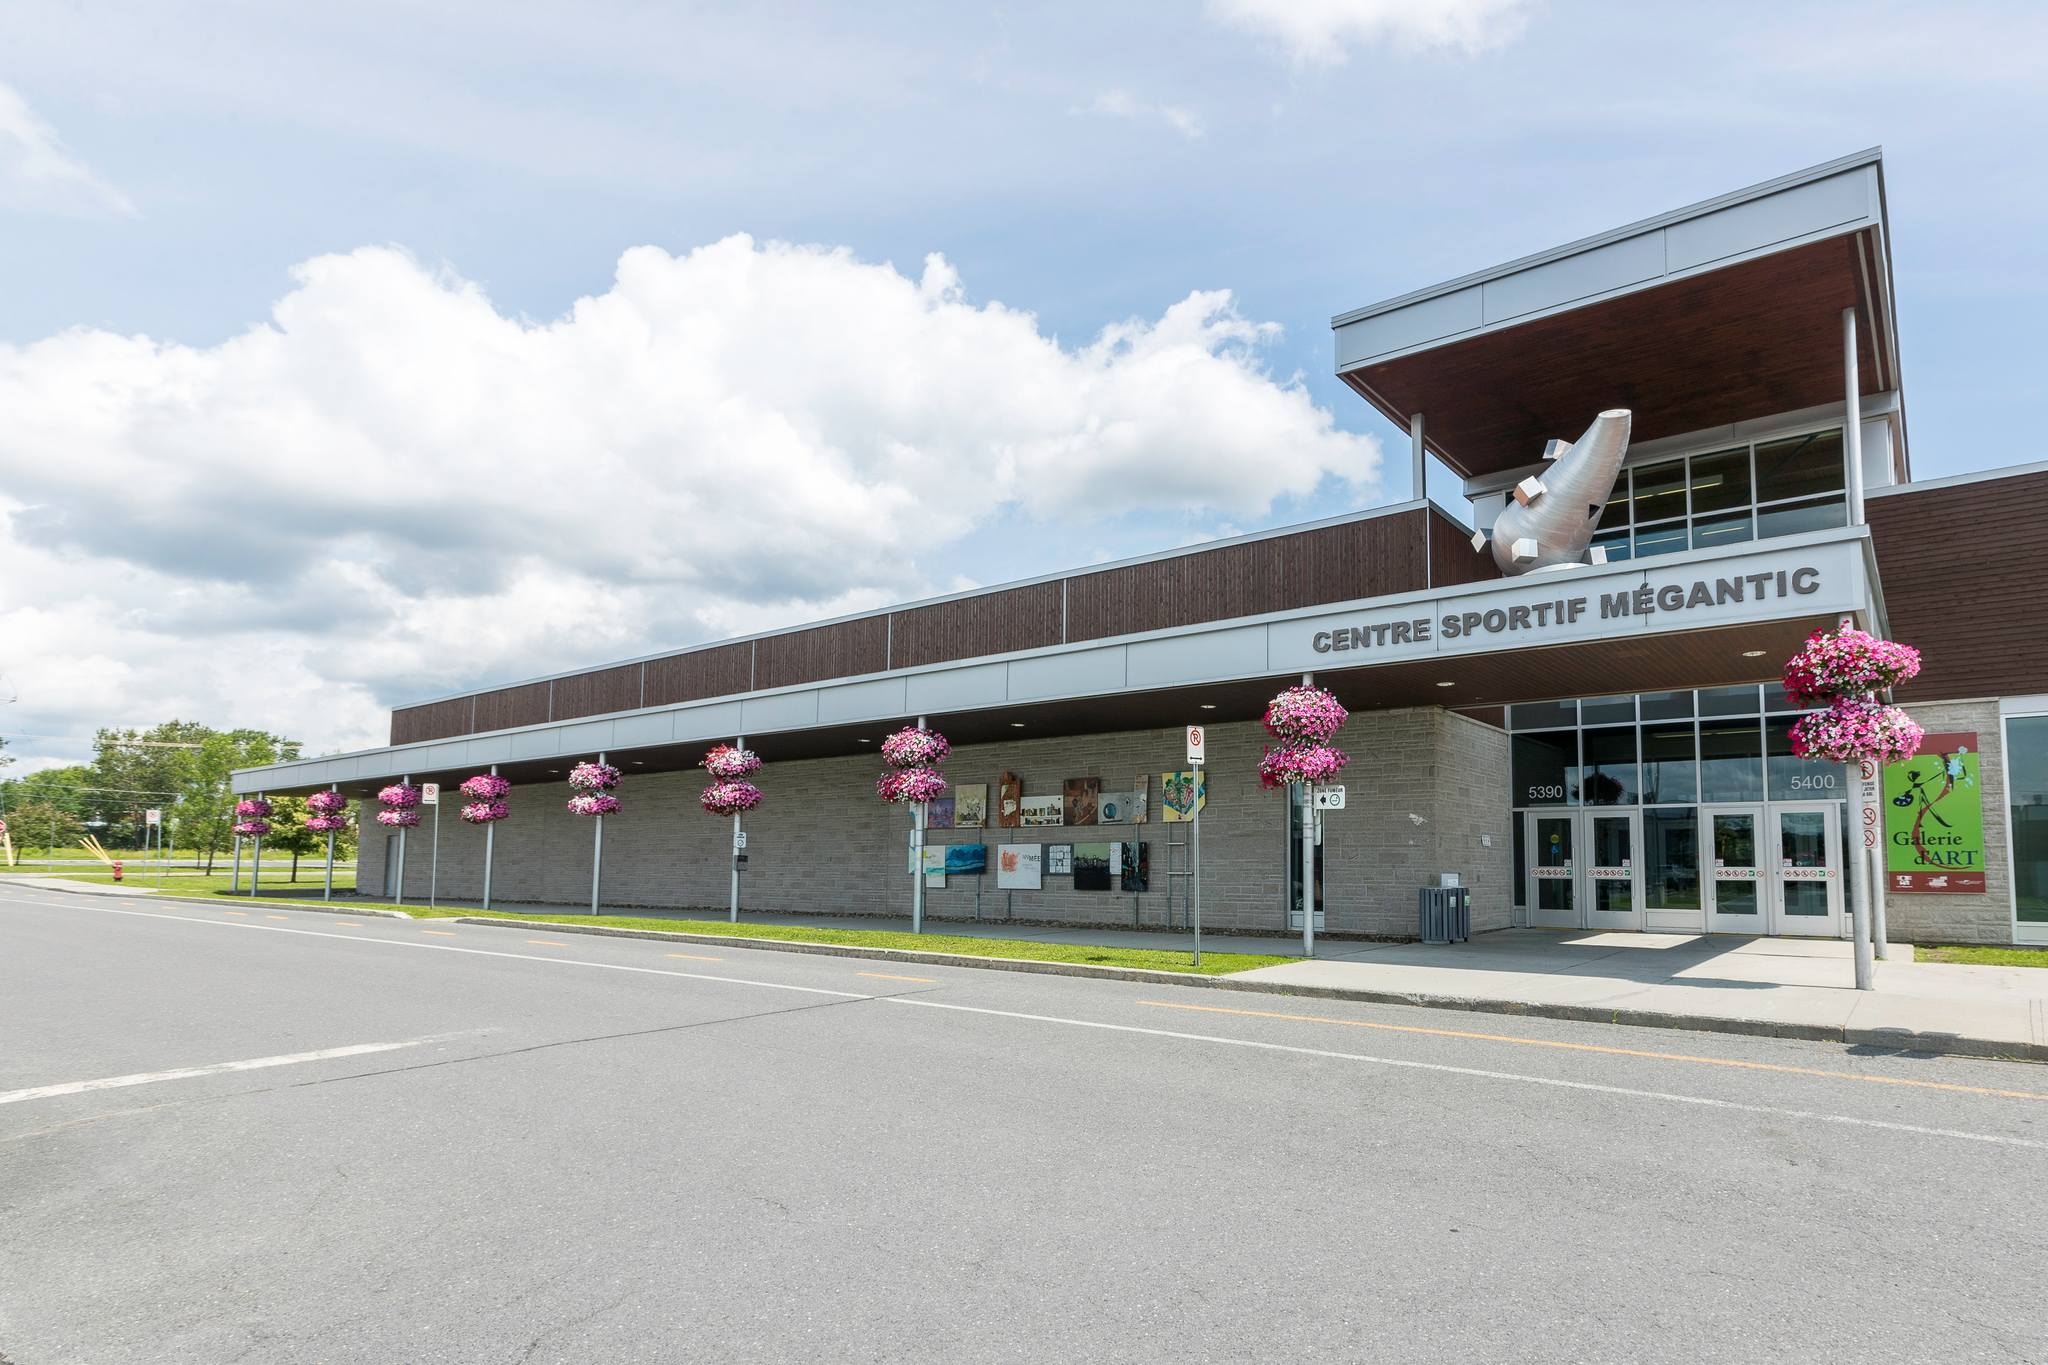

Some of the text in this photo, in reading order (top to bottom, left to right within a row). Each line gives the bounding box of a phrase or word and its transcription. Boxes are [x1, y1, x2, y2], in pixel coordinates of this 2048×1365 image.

[1312, 567, 1820, 653] CENTRE SPORTIF MÉGANTIC
[1791, 775, 1835, 790] 5400
[1529, 785, 1563, 799] 5390
[1893, 831, 1962, 846] Galerie
[1914, 850, 1978, 866] d'ART
